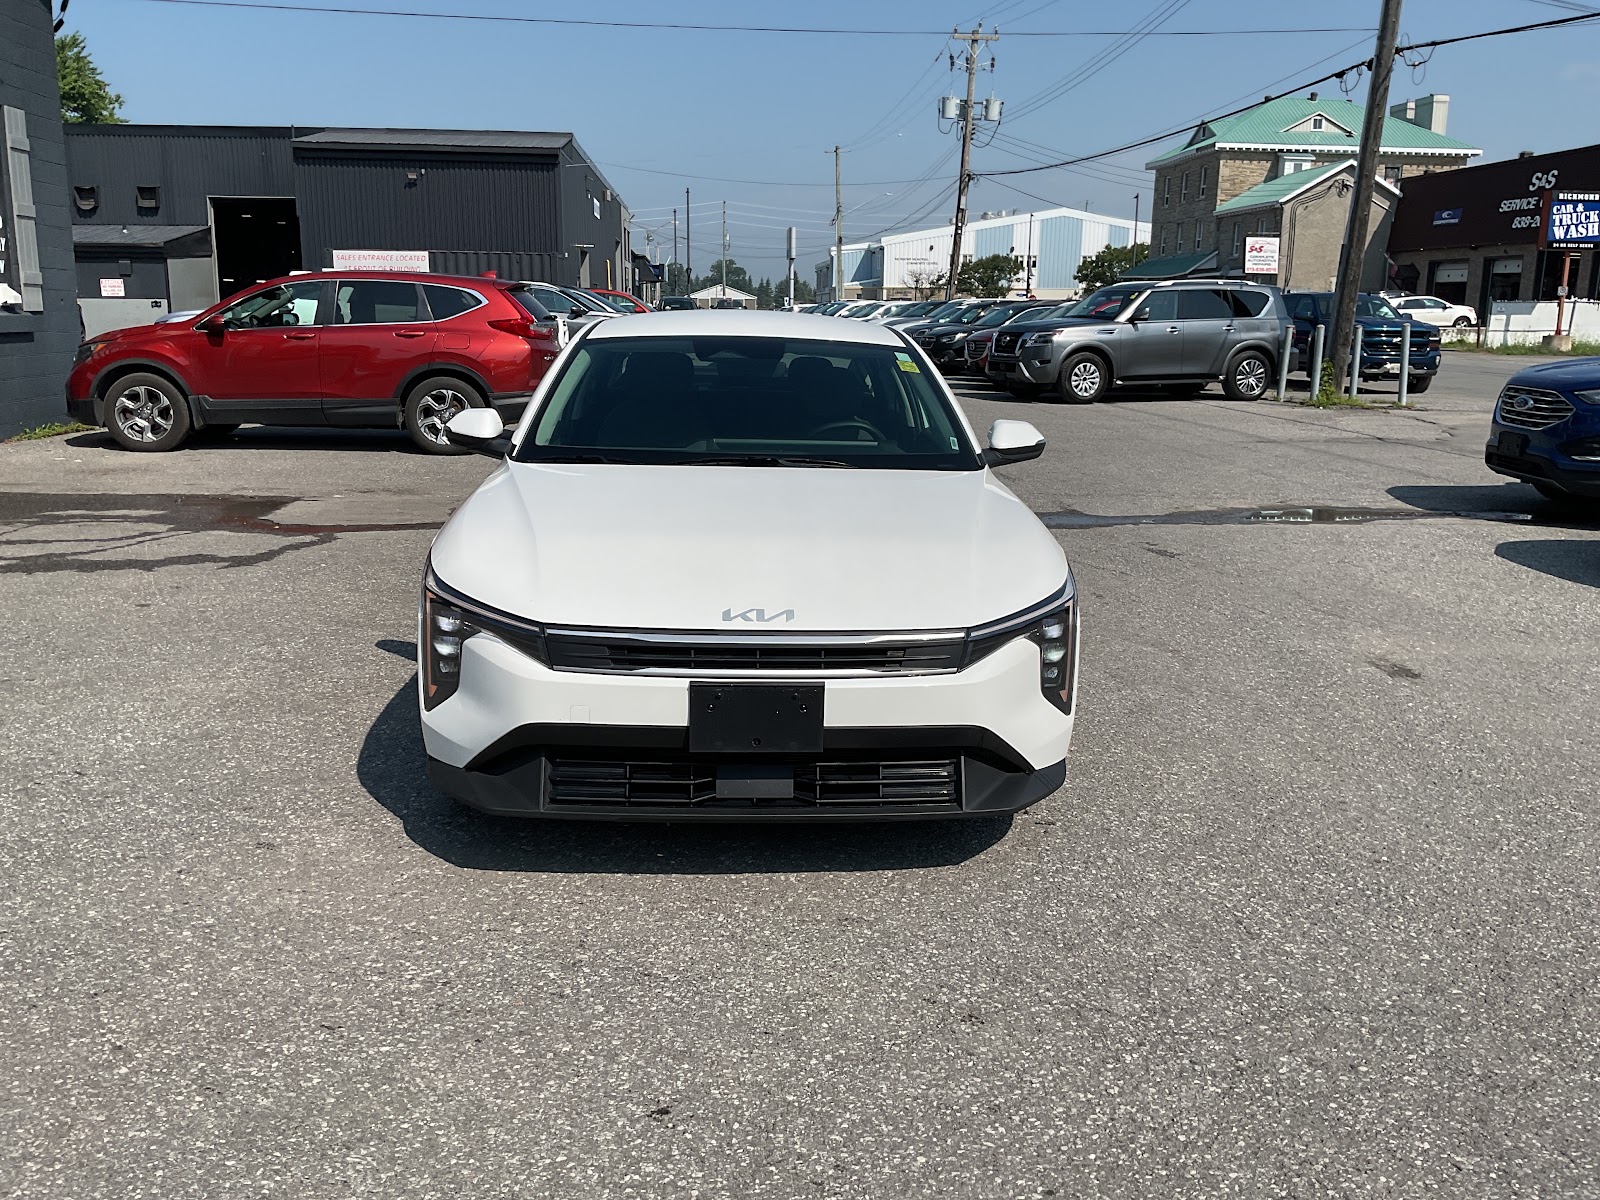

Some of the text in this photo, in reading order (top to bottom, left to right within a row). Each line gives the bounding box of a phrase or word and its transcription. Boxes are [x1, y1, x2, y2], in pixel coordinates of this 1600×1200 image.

[1529, 169, 1558, 191] S&S
[1499, 197, 1539, 212] SERVICE
[1558, 193, 1600, 201] RICHMOND
[1552, 203, 1585, 214] CAR &
[1552, 210, 1600, 226] TRUCK
[1552, 222, 1600, 240] WASH
[358, 254, 394, 262] ENTRANCE
[396, 254, 426, 262] LOCATED
